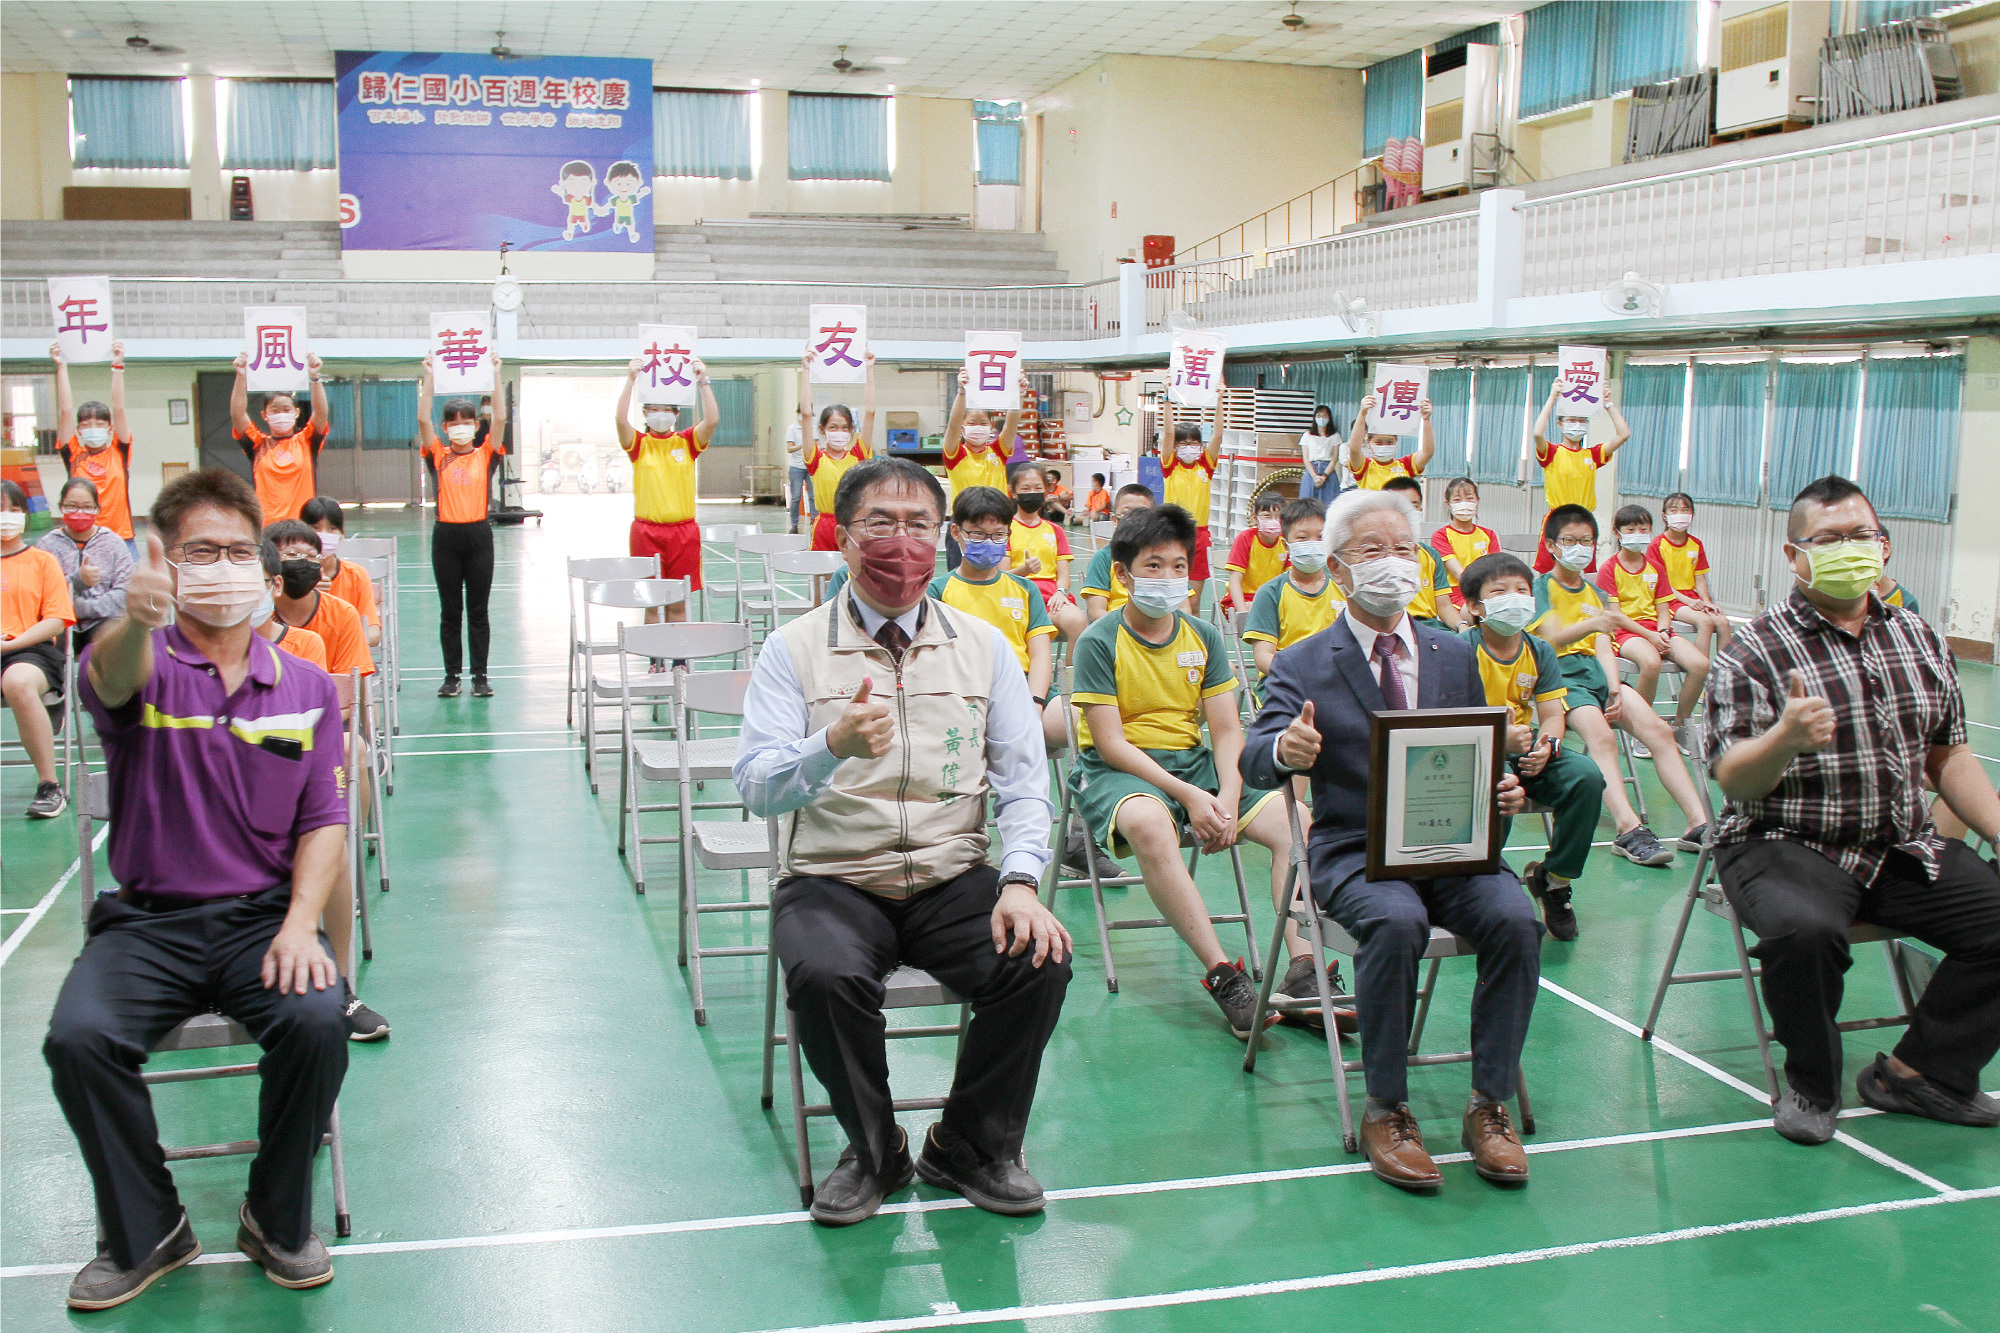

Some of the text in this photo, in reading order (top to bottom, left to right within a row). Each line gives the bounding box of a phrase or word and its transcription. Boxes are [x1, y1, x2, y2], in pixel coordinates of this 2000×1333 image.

[361, 75, 627, 107] 歸仁國小百週年校慶
[340, 199, 355, 223] S
[59, 298, 107, 344] 年
[251, 326, 304, 370] 風
[437, 328, 487, 374] 華
[642, 342, 691, 387] 校
[816, 322, 862, 367] 友
[969, 351, 1016, 391] 百
[1176, 346, 1215, 389] 萬
[1562, 361, 1599, 403] 愛
[1377, 380, 1419, 420] 傳
